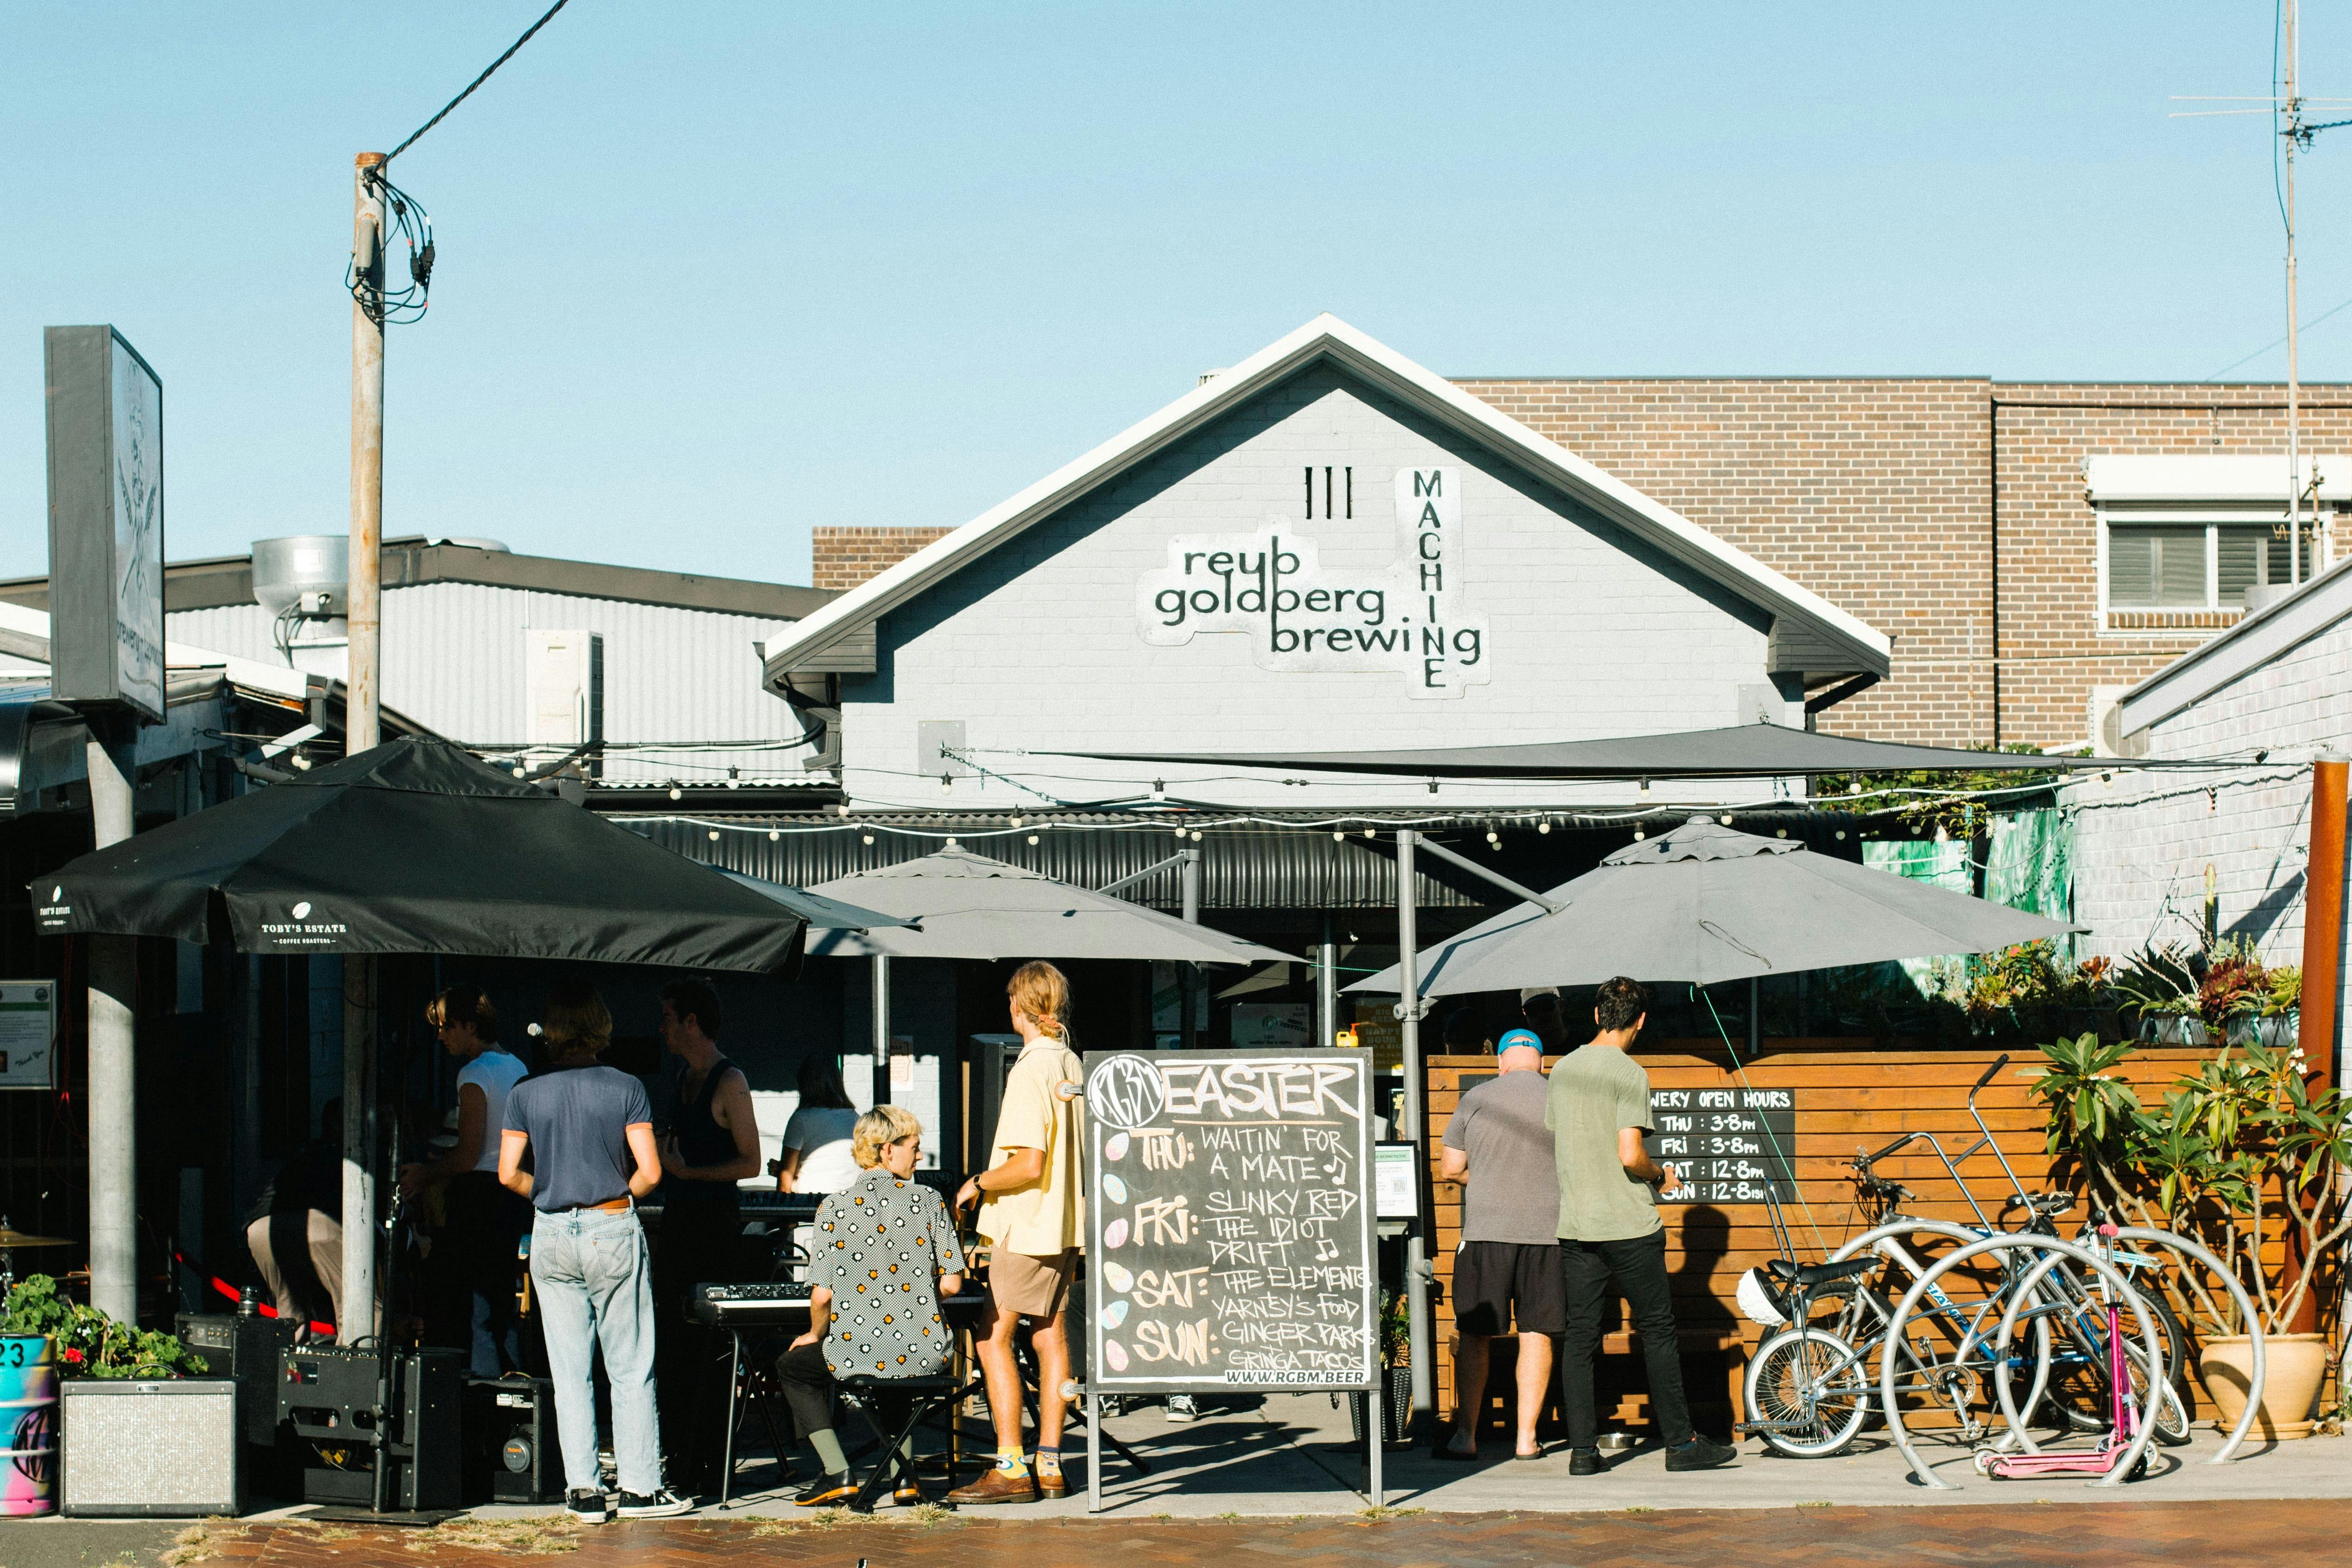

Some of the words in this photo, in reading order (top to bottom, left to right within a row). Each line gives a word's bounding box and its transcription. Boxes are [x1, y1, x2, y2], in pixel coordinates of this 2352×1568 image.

[1414, 470, 1446, 687] MACHINE
[1155, 571, 1384, 625] goldberg
[262, 924, 302, 933] TOBY'S
[304, 924, 346, 933] ESTATE
[1161, 1064, 1360, 1119] EASTER
[1651, 1091, 1690, 1107] WERY
[1699, 1091, 1734, 1108] OPEN
[1744, 1091, 1791, 1108] HOURS
[1660, 1115, 1692, 1132] THU
[1303, 1129, 1353, 1158] FOR
[1210, 1153, 1229, 1180] A
[1242, 1154, 1321, 1182] MATE
[1206, 1189, 1298, 1215] SLINKY
[1305, 1189, 1358, 1218] RED
[1201, 1217, 1258, 1239] THE
[1270, 1217, 1338, 1241] IDIOT
[1207, 1240, 1294, 1266] DRIFT
[1132, 1267, 1209, 1308] SAT:
[1211, 1269, 1264, 1294] THE
[1133, 1318, 1221, 1367] SUN:
[1222, 1320, 1318, 1347] GINGER
[1228, 1348, 1302, 1371] GRINGA
[1226, 1371, 1364, 1383] WWW.RGBM.BEER
